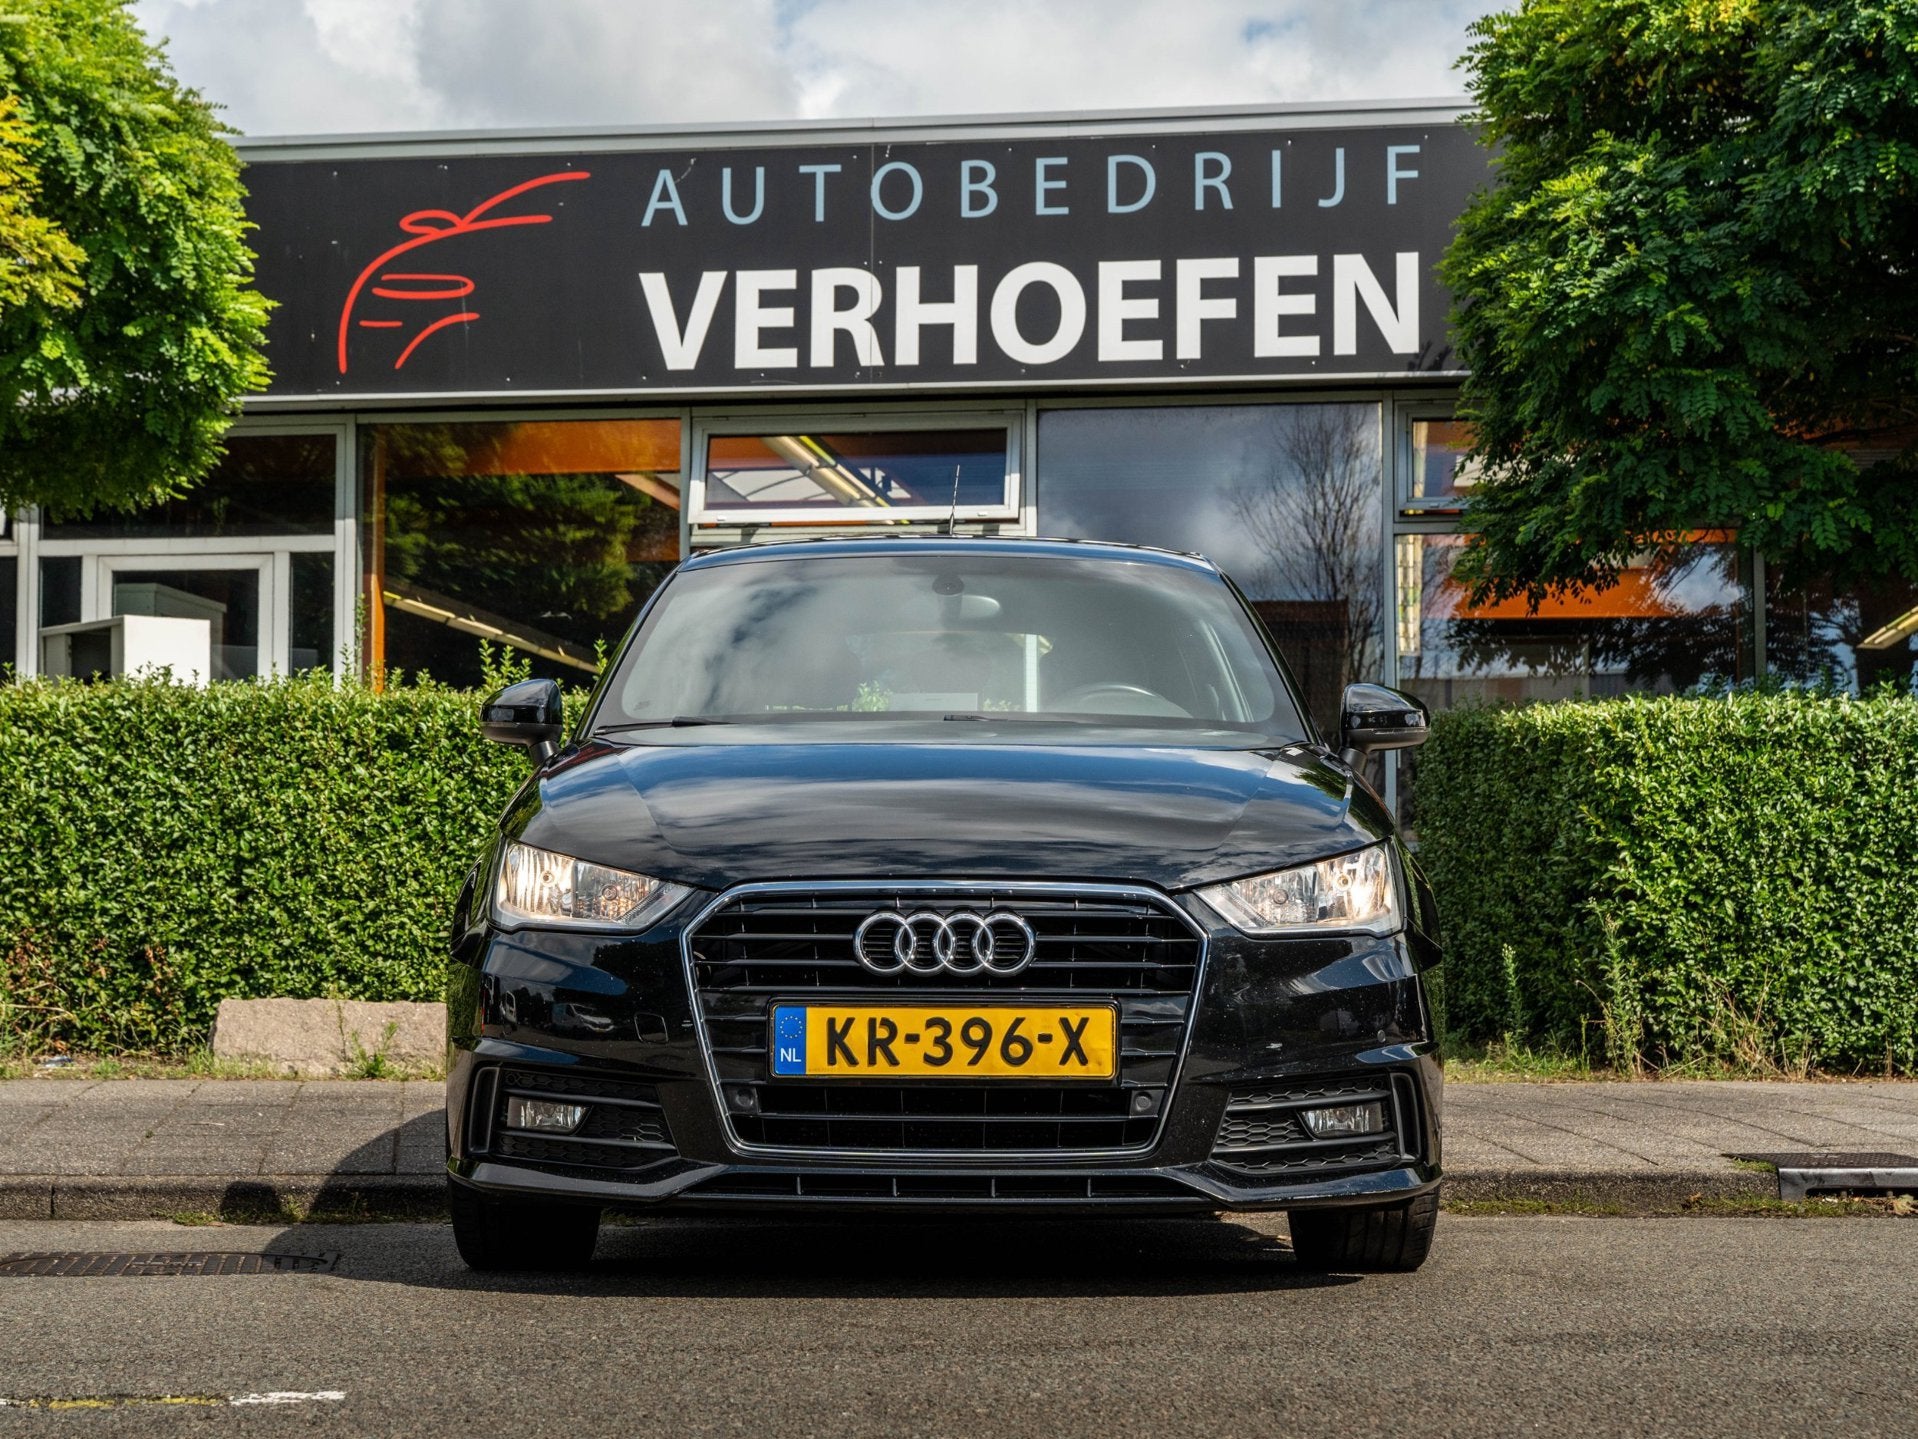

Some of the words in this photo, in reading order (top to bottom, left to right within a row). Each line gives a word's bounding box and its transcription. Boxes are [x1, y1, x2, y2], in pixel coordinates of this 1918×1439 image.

[641, 145, 1421, 227] AUTOBEDRIJF
[639, 251, 1420, 370] VERHOEFEN
[780, 1048, 801, 1062] NL
[826, 1016, 1090, 1067] KR-396-X
